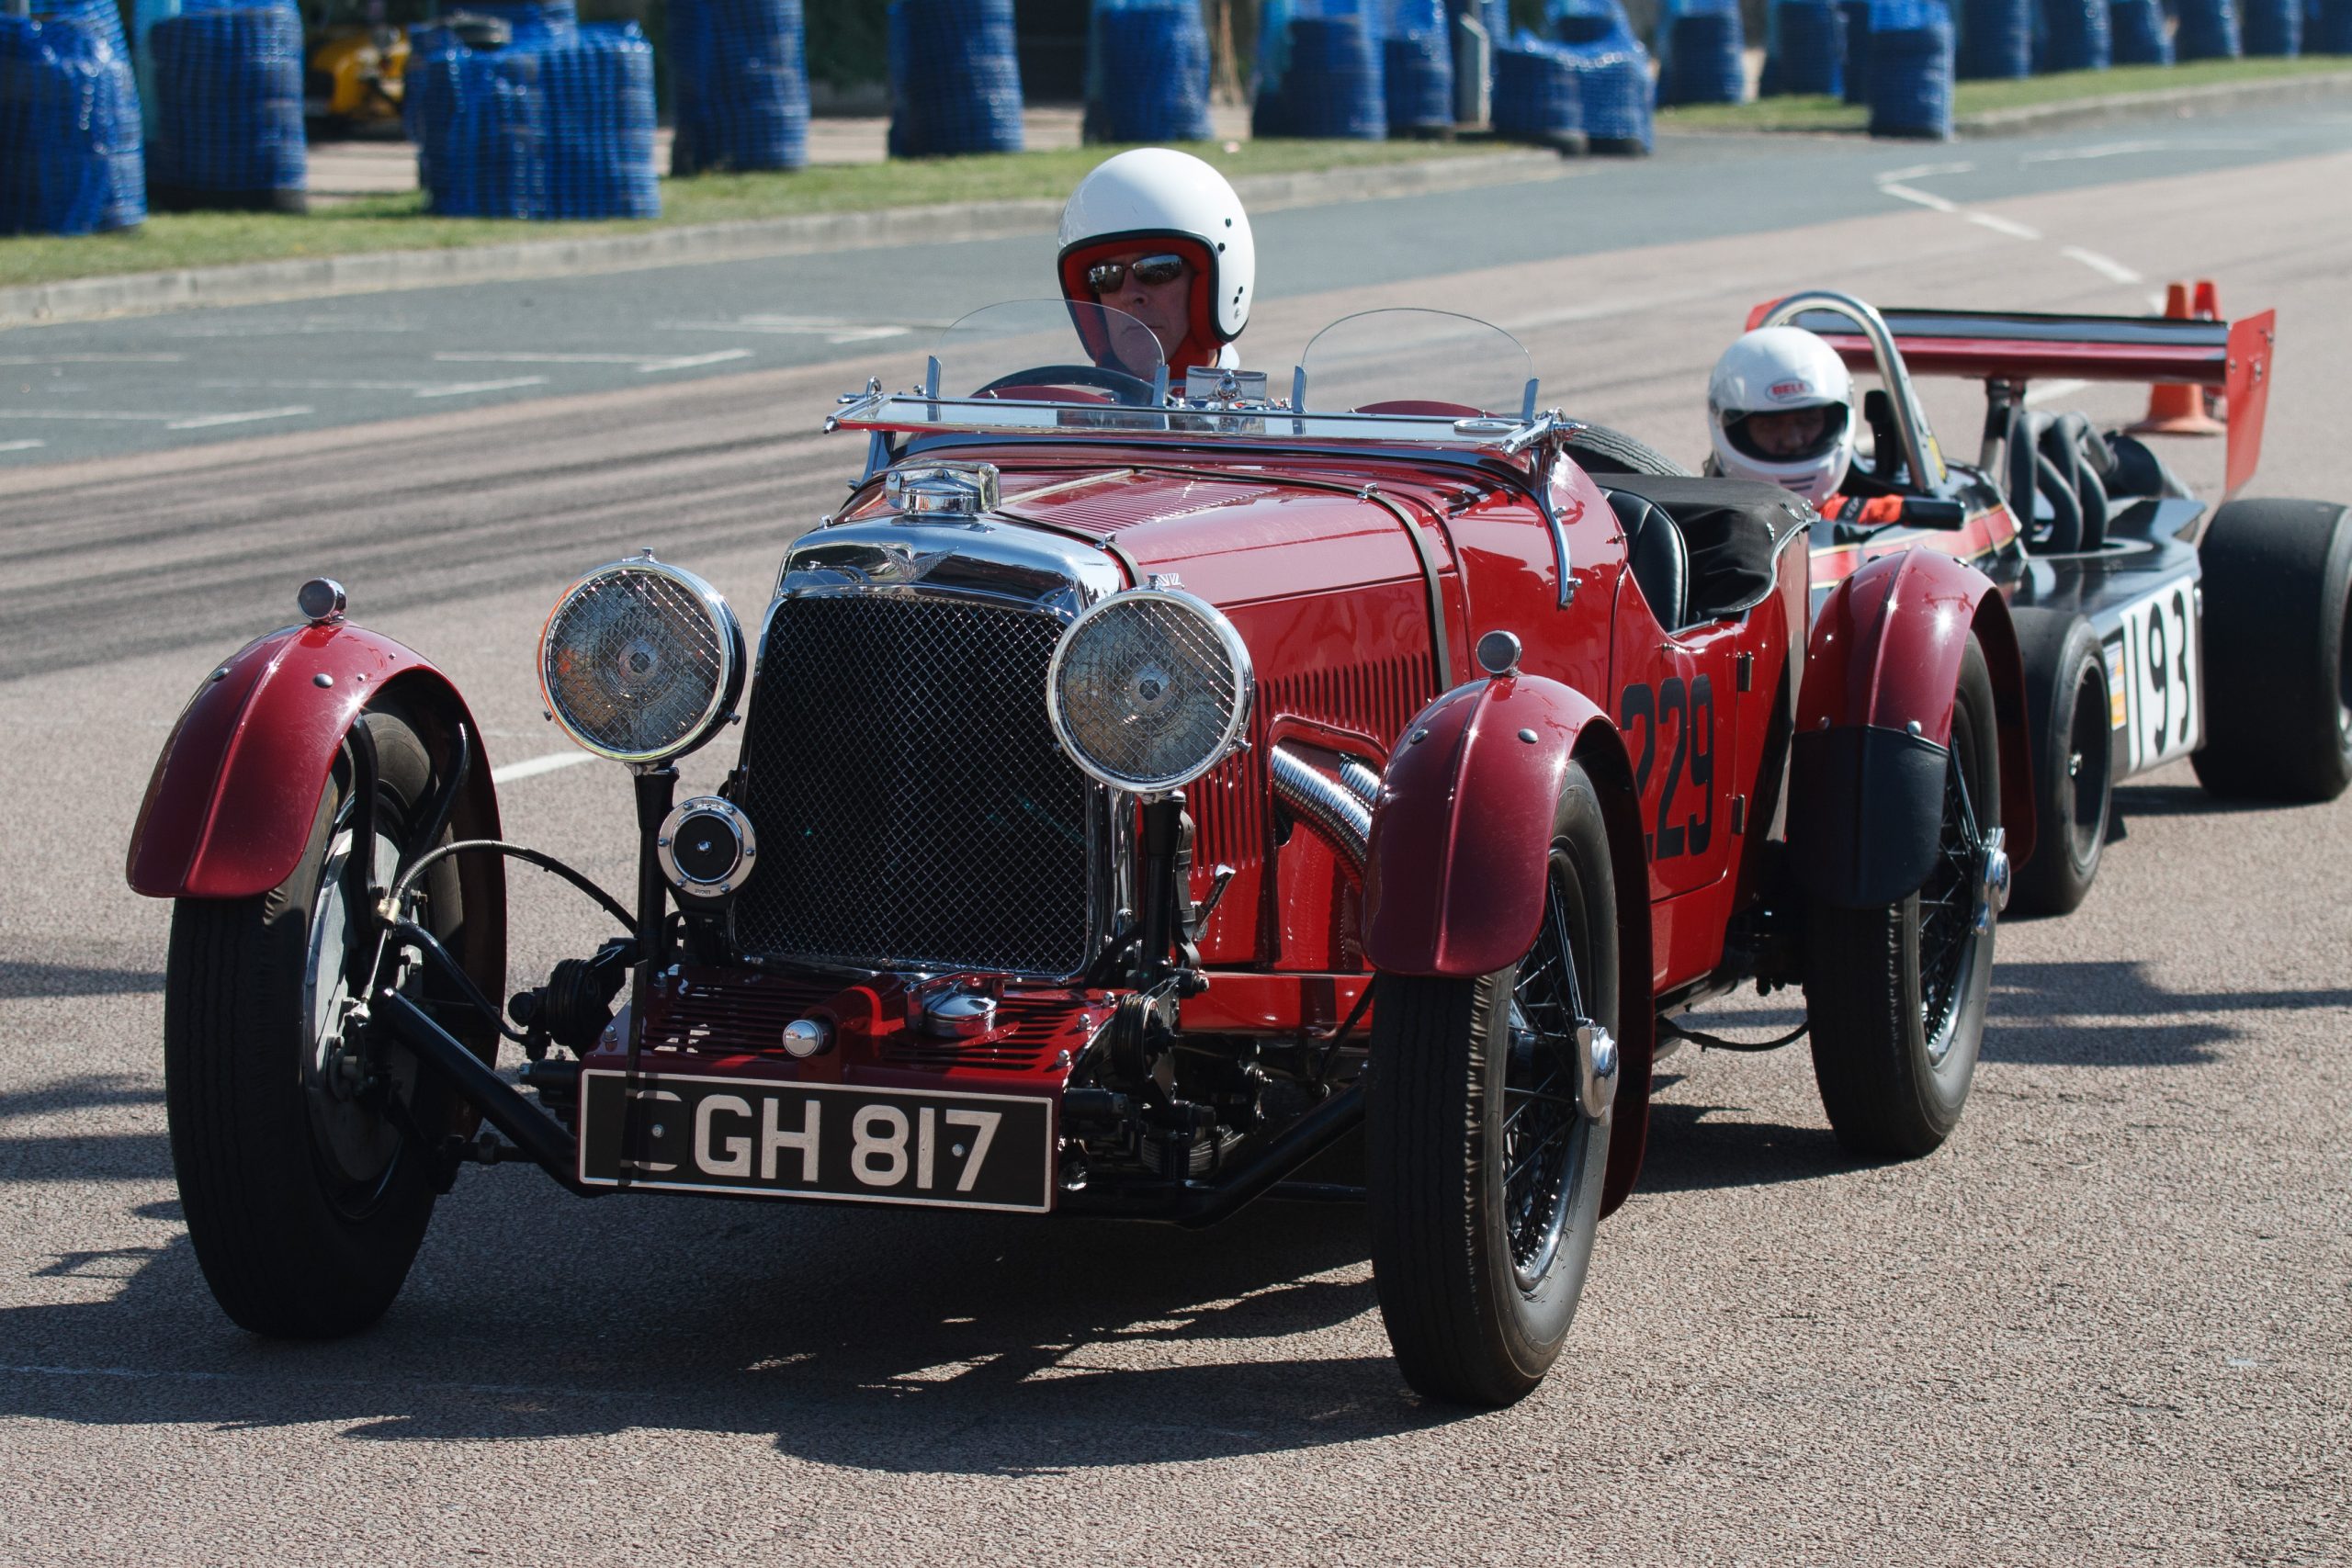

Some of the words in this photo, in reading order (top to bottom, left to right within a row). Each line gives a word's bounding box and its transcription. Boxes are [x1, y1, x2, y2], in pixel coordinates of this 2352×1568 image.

[1771, 382, 1804, 396] BELL
[1621, 673, 1713, 865] 229
[851, 1104, 1002, 1191] 817
